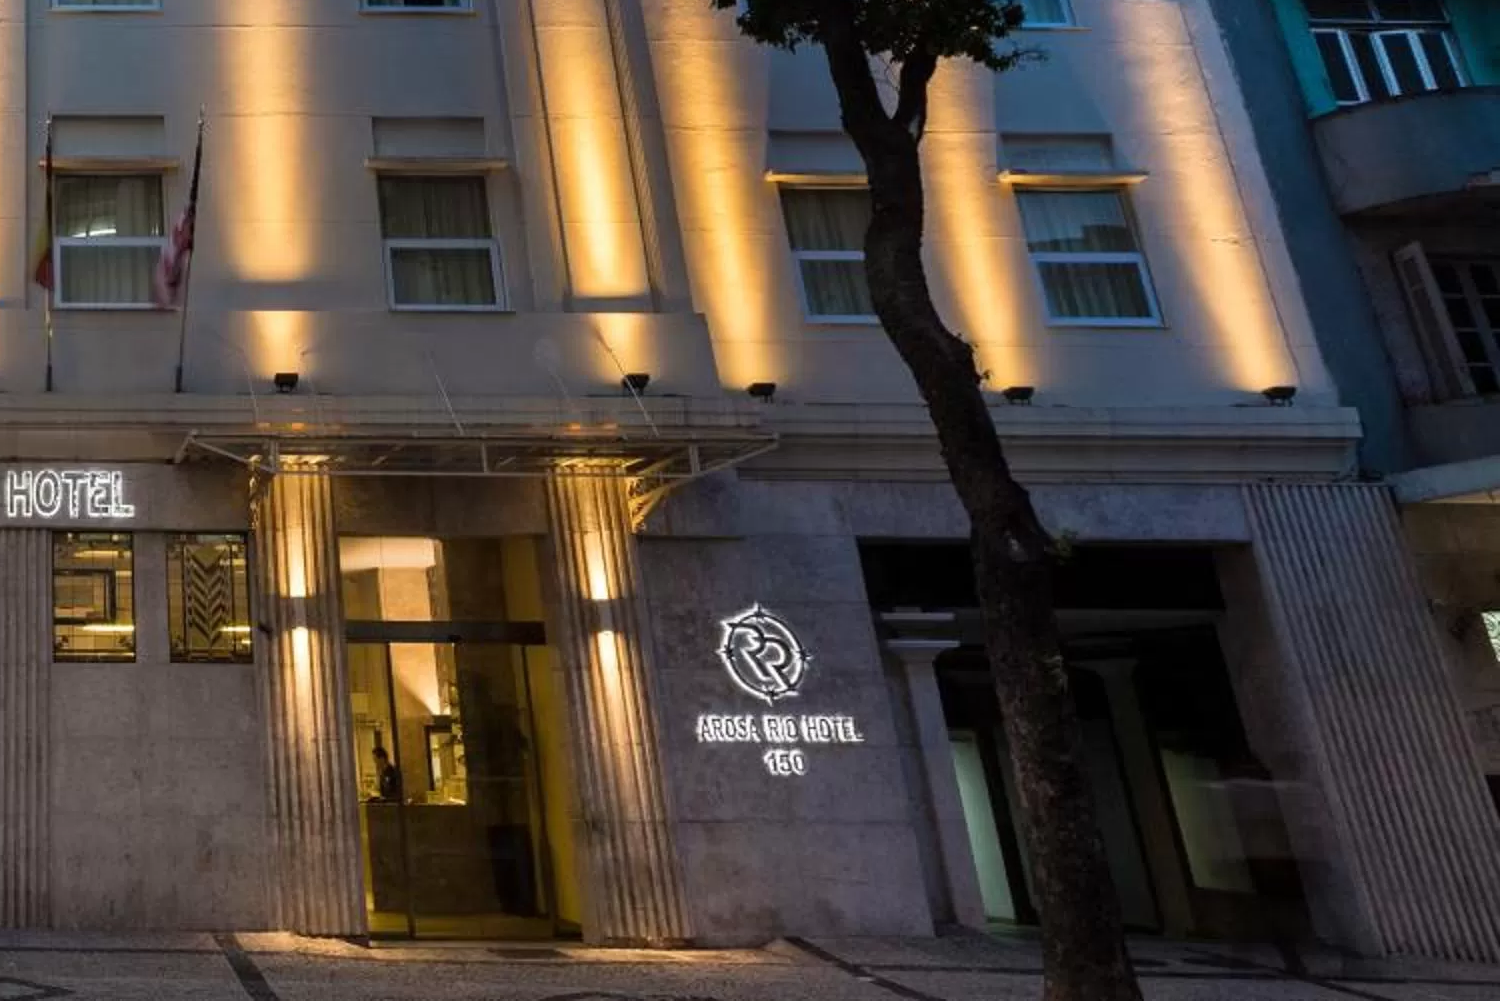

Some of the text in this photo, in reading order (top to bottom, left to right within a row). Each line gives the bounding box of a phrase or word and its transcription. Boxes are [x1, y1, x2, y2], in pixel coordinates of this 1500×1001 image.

[7, 470, 135, 518] HOTEL
[697, 715, 864, 742] AROSA RIO HOTEL
[764, 750, 805, 775] 150
